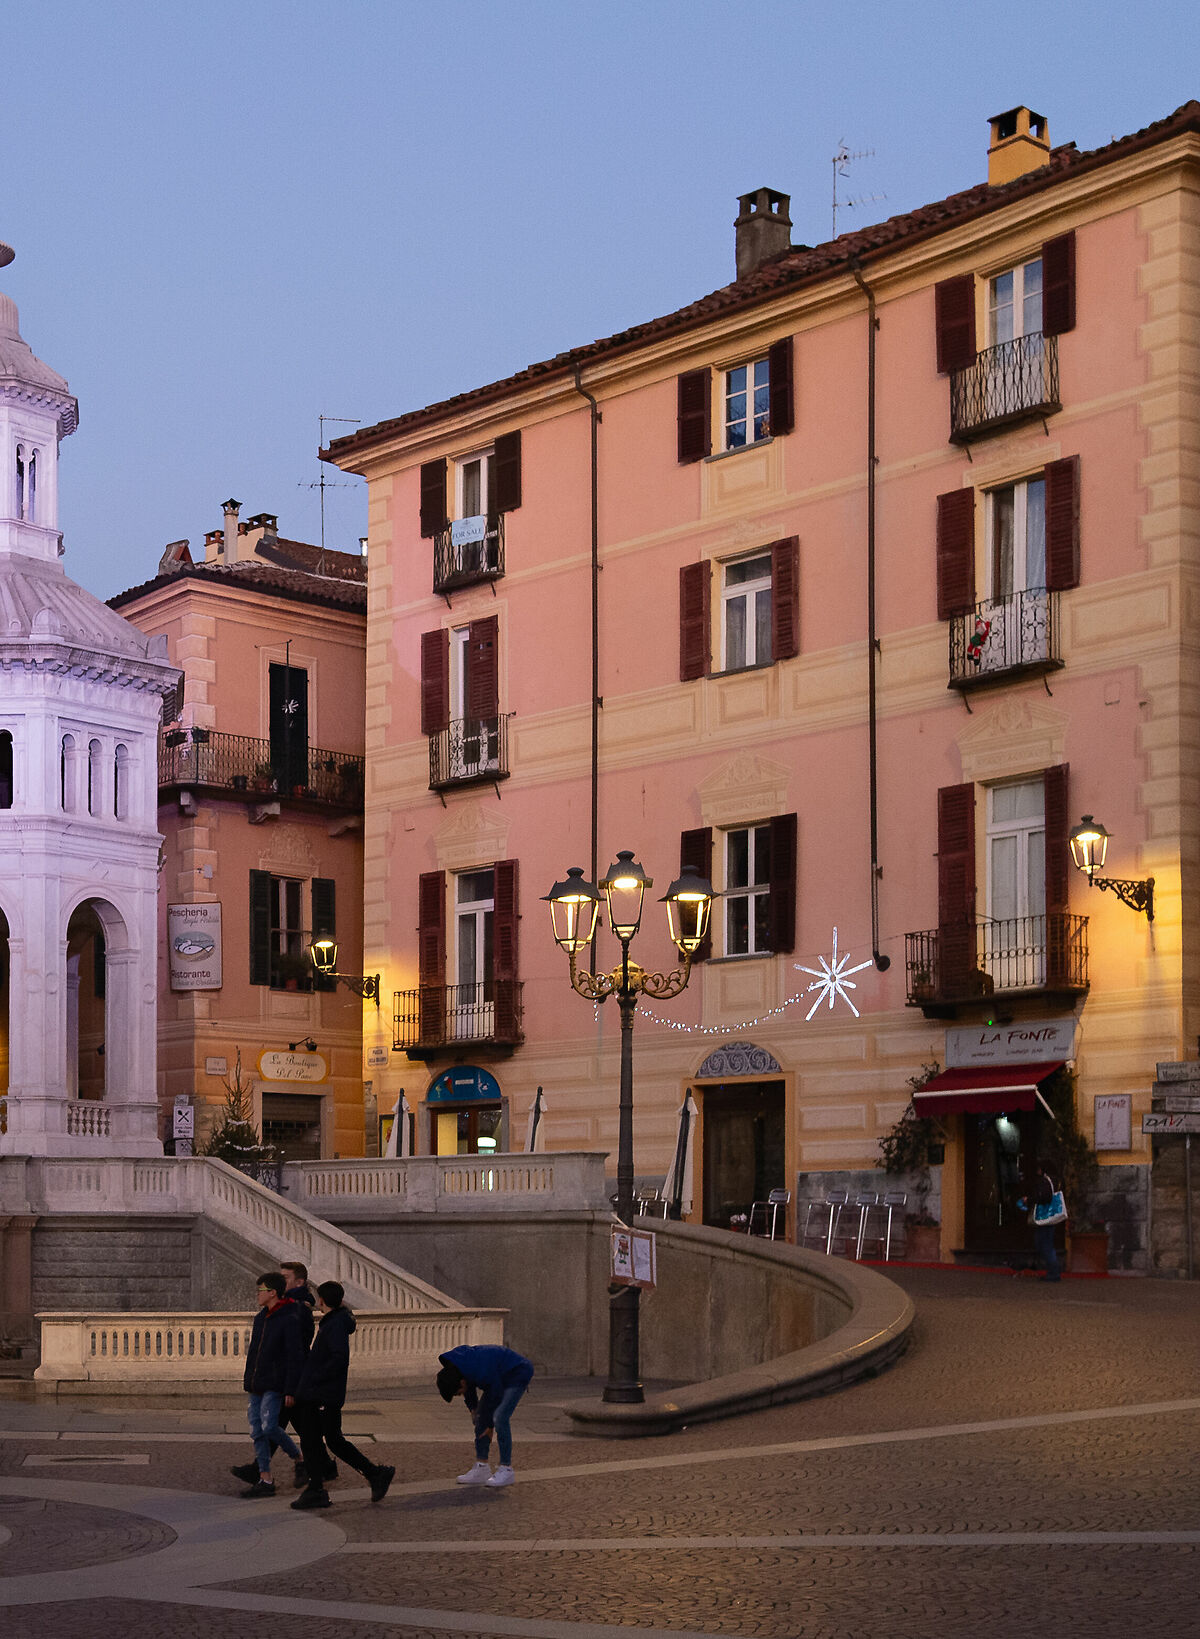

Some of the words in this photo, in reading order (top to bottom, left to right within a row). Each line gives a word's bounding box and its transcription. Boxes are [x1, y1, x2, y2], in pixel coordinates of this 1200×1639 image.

[452, 531, 466, 539] FOR
[169, 907, 208, 919] Pescheria
[980, 1033, 1001, 1045] LA
[1007, 1027, 1060, 1044] FONTE
[270, 1054, 281, 1065] La
[285, 1054, 318, 1069] Boutique
